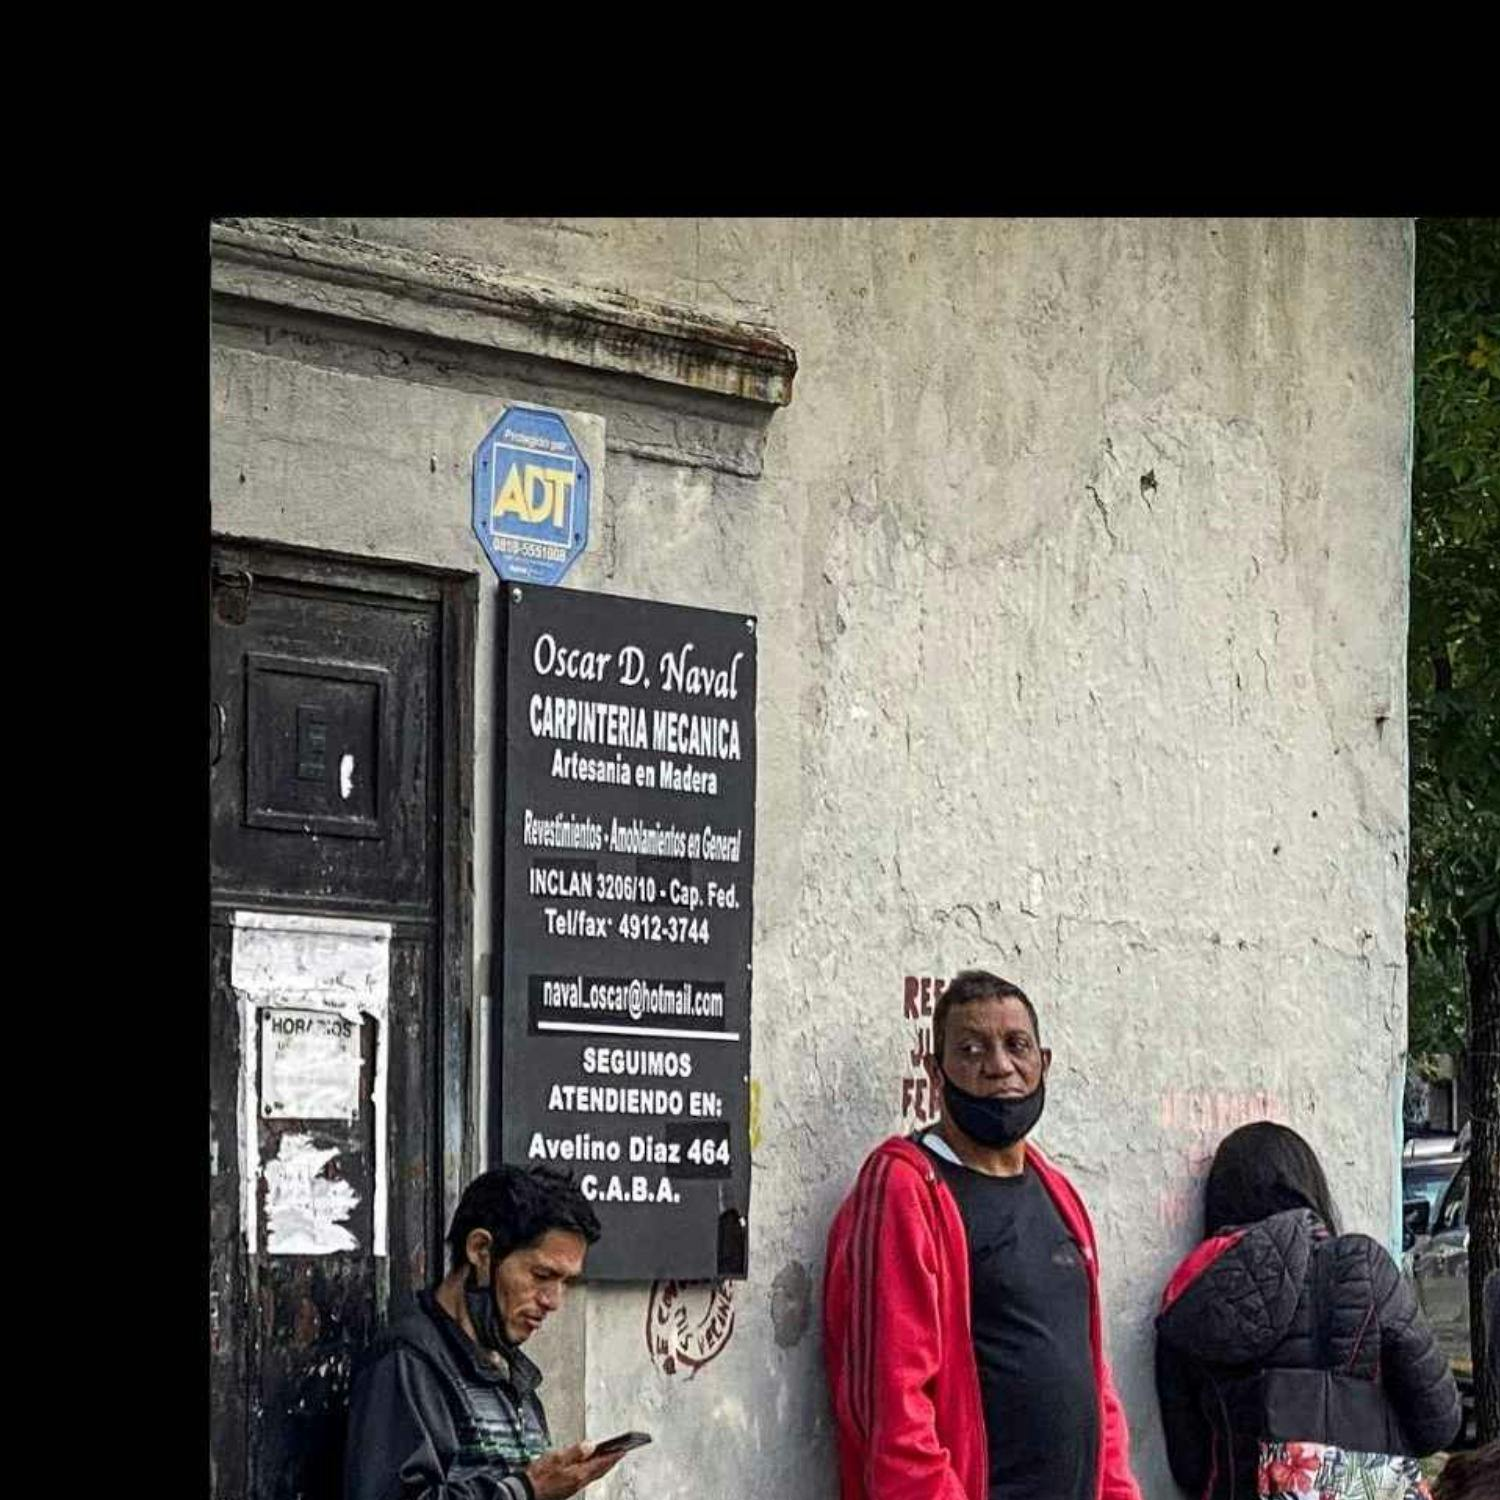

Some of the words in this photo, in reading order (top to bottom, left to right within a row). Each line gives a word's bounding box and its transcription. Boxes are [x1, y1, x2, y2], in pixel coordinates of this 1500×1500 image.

[493, 463, 575, 528] ADT
[534, 633, 612, 682] Oscar
[618, 646, 650, 689] D.
[660, 643, 744, 700] Naval
[530, 694, 649, 750] CARPINTERIA
[652, 709, 741, 760] MECANICA
[551, 748, 631, 785] Artesania
[635, 765, 655, 789] en
[659, 760, 718, 795] Madera
[523, 809, 602, 850] Revestimientos
[609, 817, 687, 859] Amoblamientos
[688, 832, 701, 860] en
[702, 826, 742, 863] General
[529, 868, 593, 898] INCLAN
[597, 873, 656, 903] 3206/10
[670, 878, 704, 911] Cap.
[708, 882, 740, 909] Fed.
[619, 914, 710, 945] 4912-3744
[543, 976, 724, 1020] naval_oscar@hotmail.com
[271, 1017, 352, 1038] HORIOS
[583, 1047, 692, 1078] SEGUIMOS
[549, 1084, 683, 1116] ATENDIENDO
[689, 1092, 722, 1117] EN:
[529, 1132, 621, 1162] Avelino
[629, 1136, 681, 1164] Diaz
[687, 1138, 730, 1166] 464
[581, 1174, 681, 1203] C.A.B.A.
